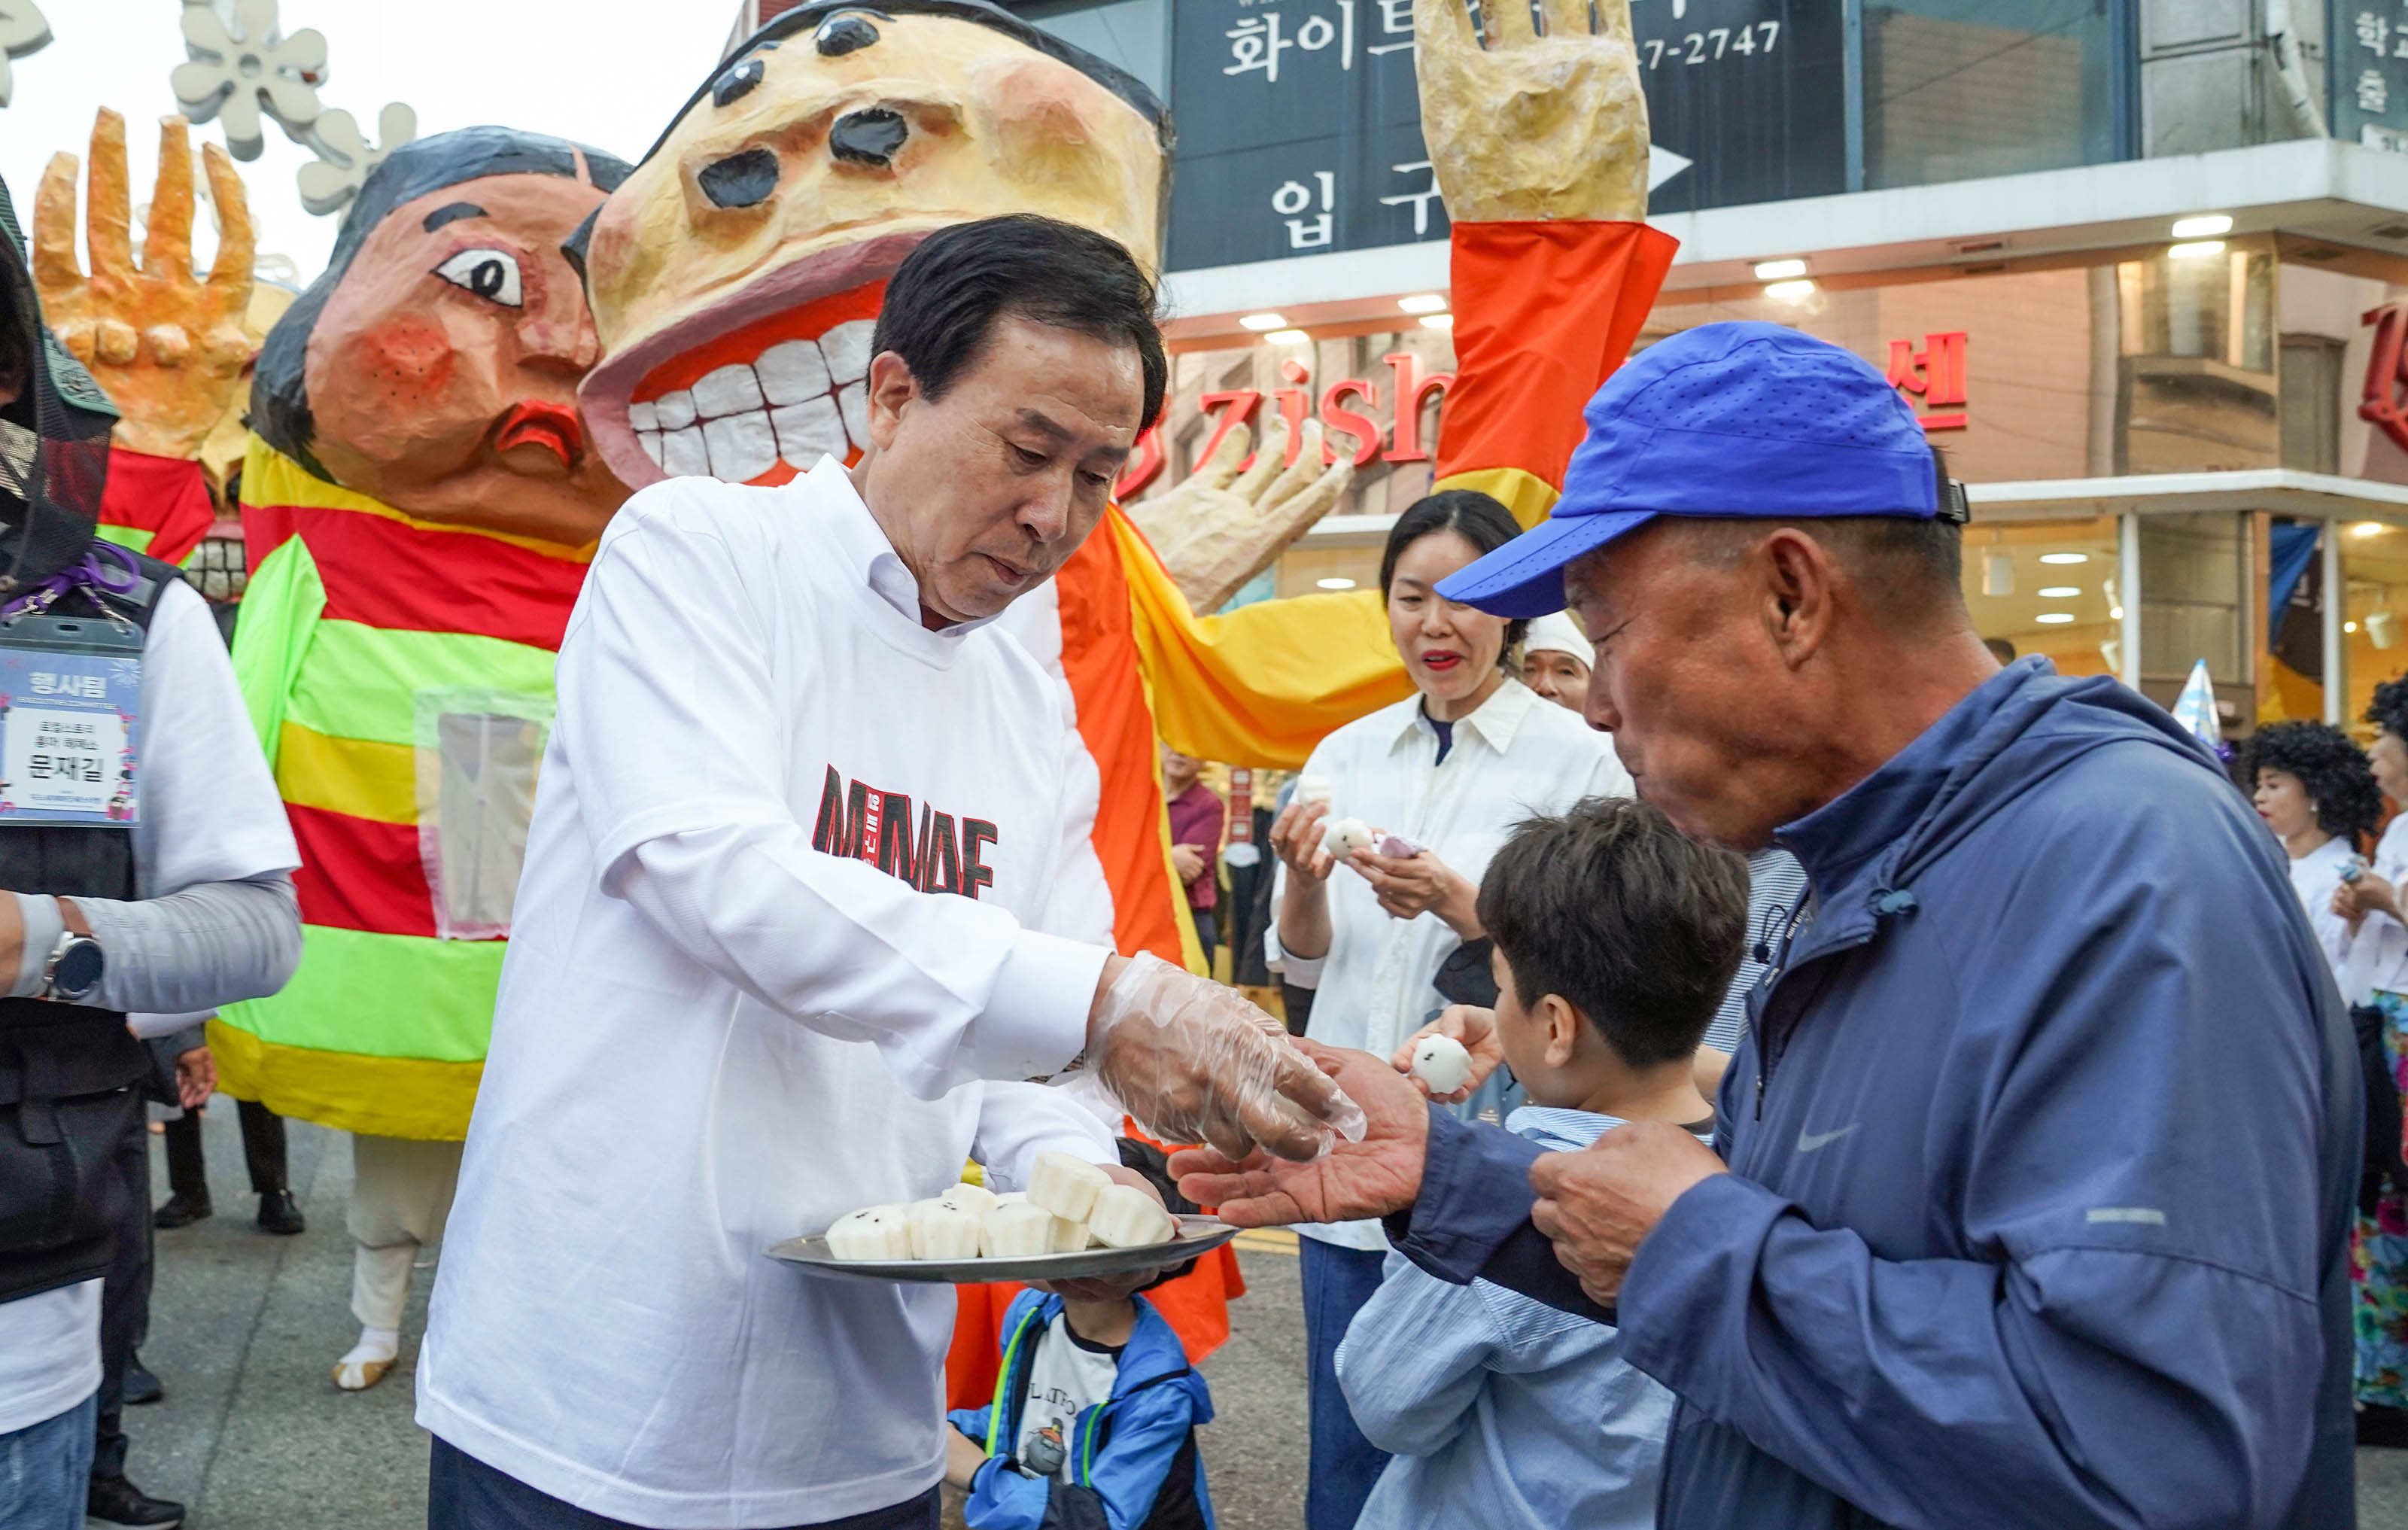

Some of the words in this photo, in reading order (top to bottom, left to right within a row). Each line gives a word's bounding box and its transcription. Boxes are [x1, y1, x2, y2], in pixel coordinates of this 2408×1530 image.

[1223, 0, 1415, 83] 화이트
[1638, 20, 1780, 70] 7-2747
[1114, 352, 1458, 503] zish
[28, 753, 105, 783] 문재길
